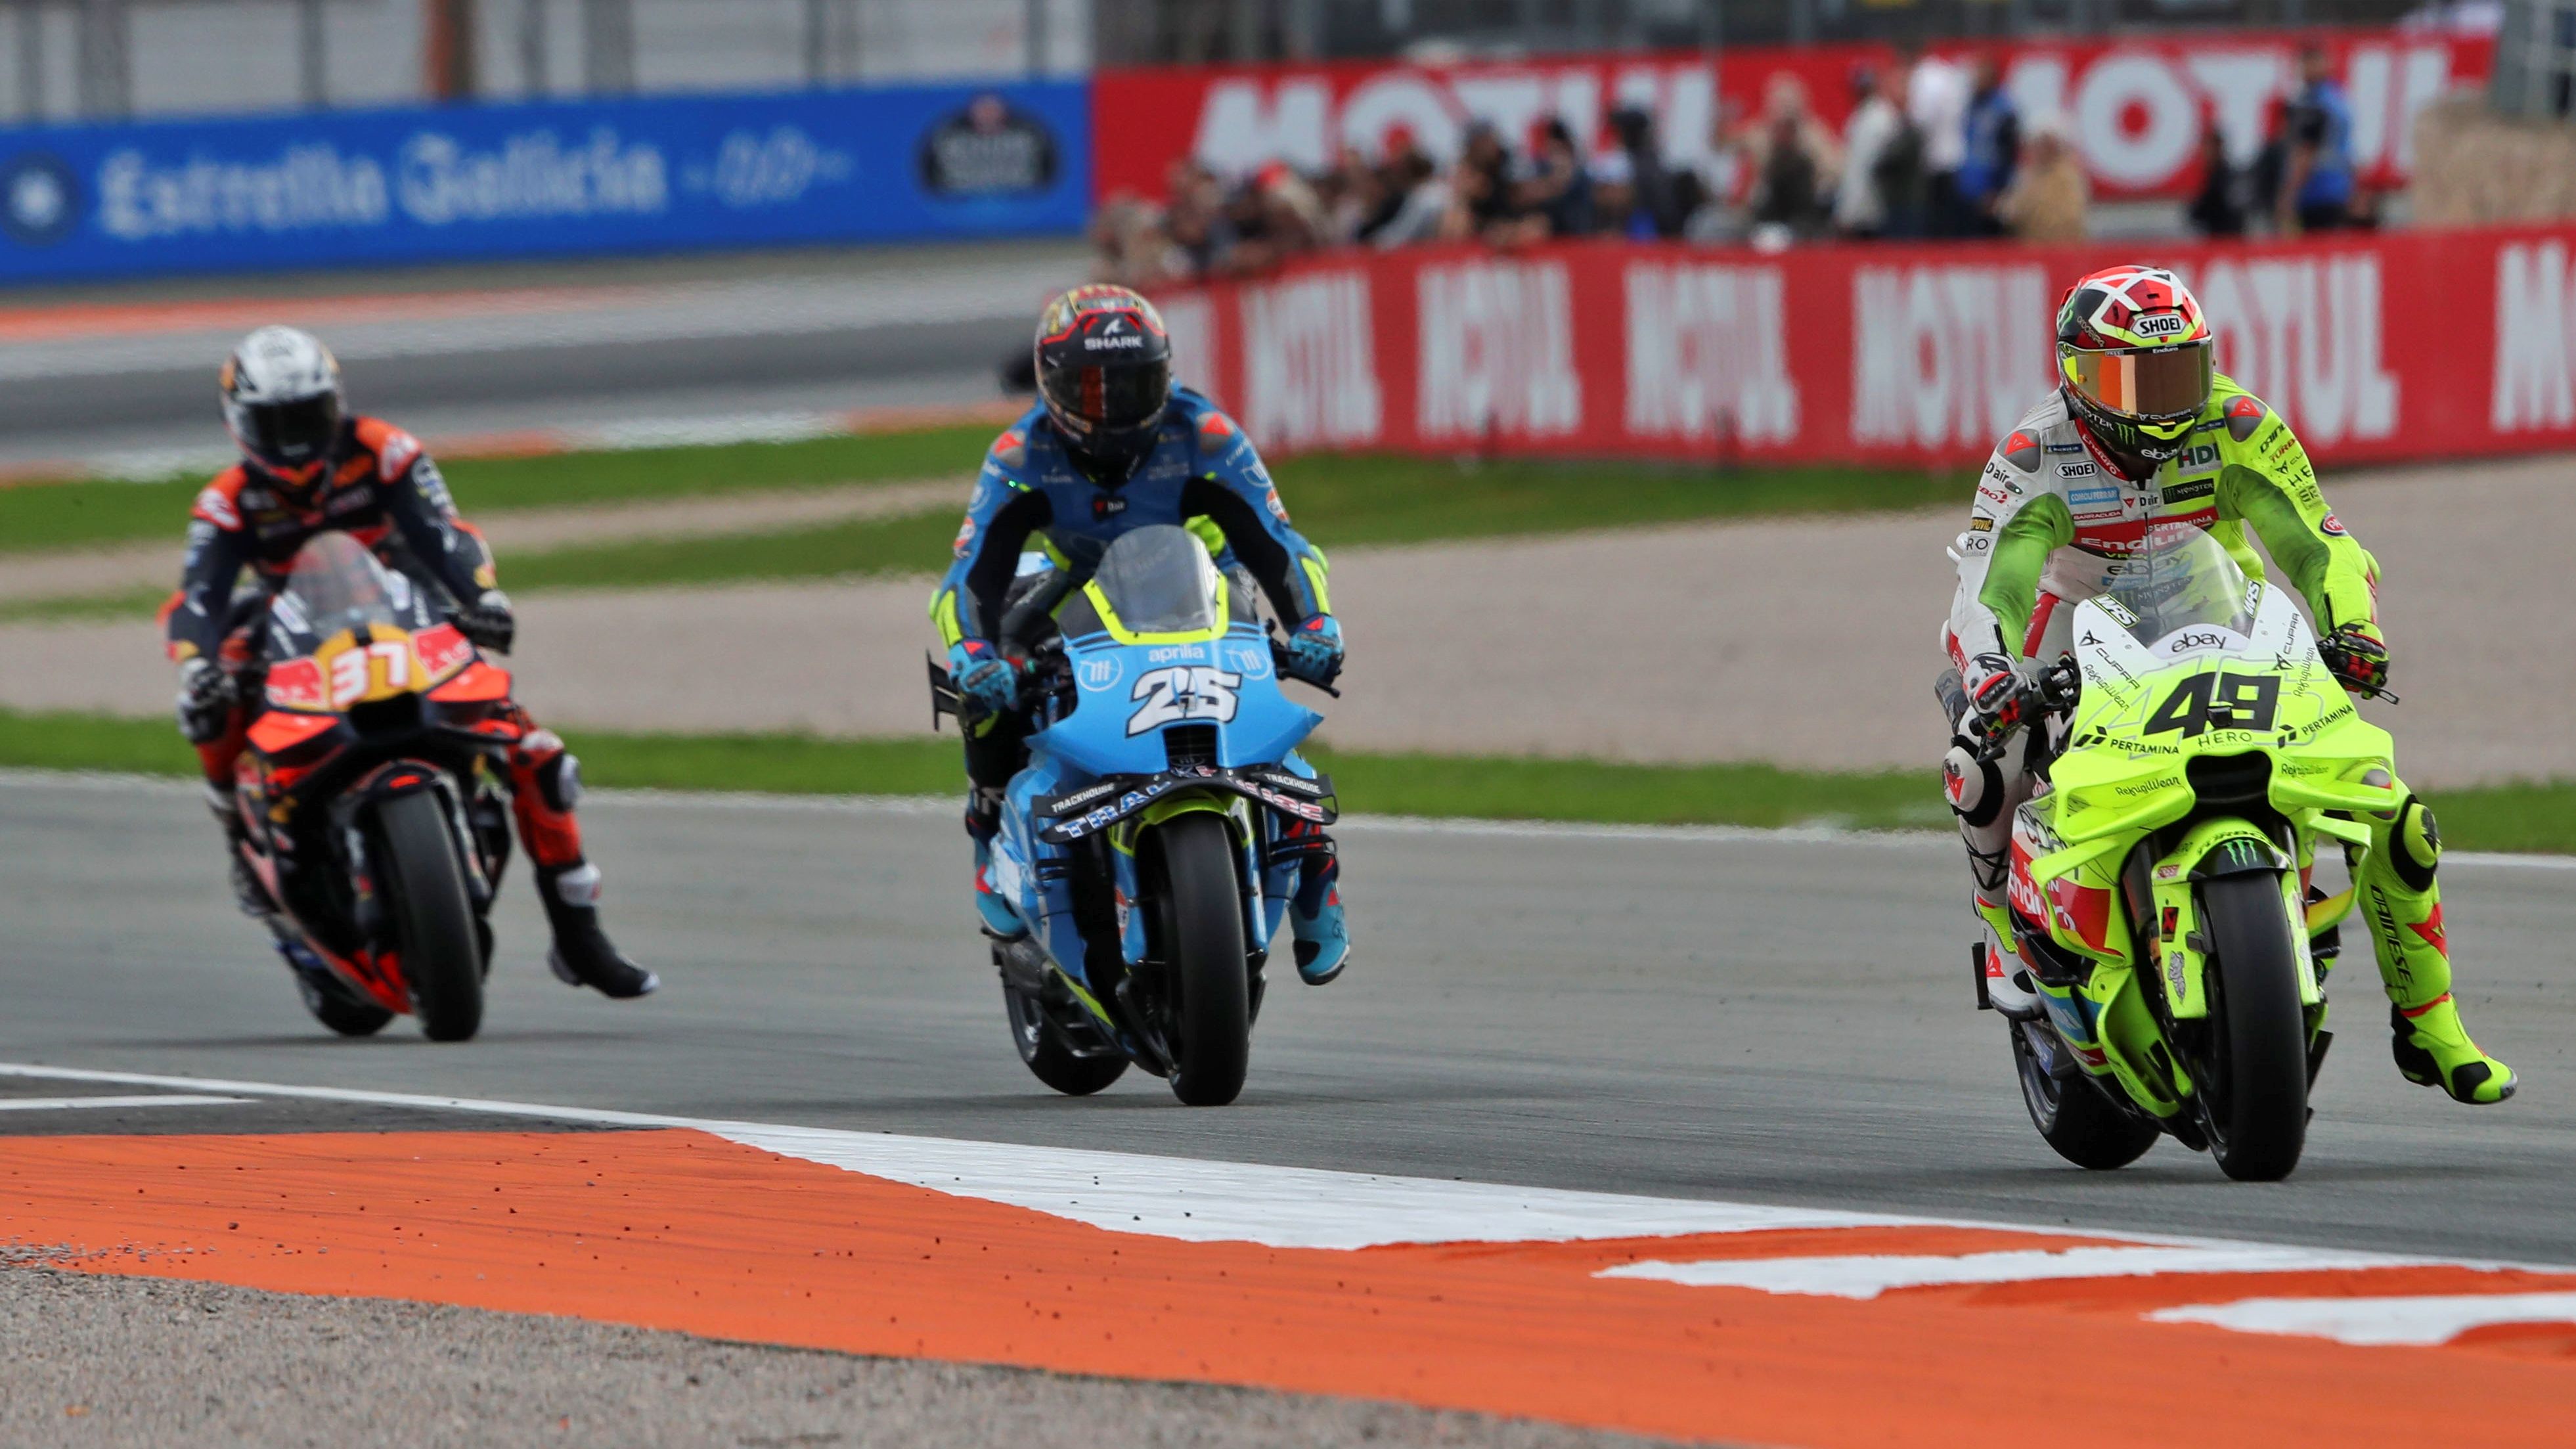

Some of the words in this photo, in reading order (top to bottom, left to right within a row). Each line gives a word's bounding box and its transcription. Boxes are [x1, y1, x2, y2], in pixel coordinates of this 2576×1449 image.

[2139, 317, 2181, 335] SHOEI
[2495, 242, 2576, 430] M
[1084, 335, 1144, 351] SHARK
[1849, 264, 2054, 448] MOTUL
[2179, 254, 2398, 447] OTUL
[2149, 408, 2192, 420] CUPRA
[2060, 462, 2095, 476] SHOEI
[2081, 434, 2121, 475] Enduro
[2178, 443, 2221, 468] HDI
[2073, 511, 2122, 521] BARRACUDA
[2171, 633, 2227, 653] ebay
[2283, 612, 2300, 655] CUPRA
[1149, 644, 1205, 663] aprilia
[2096, 647, 2141, 690] CUPRA
[331, 641, 409, 707] 37
[1125, 664, 1243, 739] 25
[2143, 671, 2281, 740] 49
[2301, 703, 2355, 736] PERTAMINA
[2110, 738, 2180, 755] PERTAMINA
[2198, 731, 2253, 748] HERO
[1052, 782, 1115, 814] TRACKHOUSE
[1264, 773, 1322, 795] TRACKHOUSE
[2370, 883, 2415, 985] DAINESE
